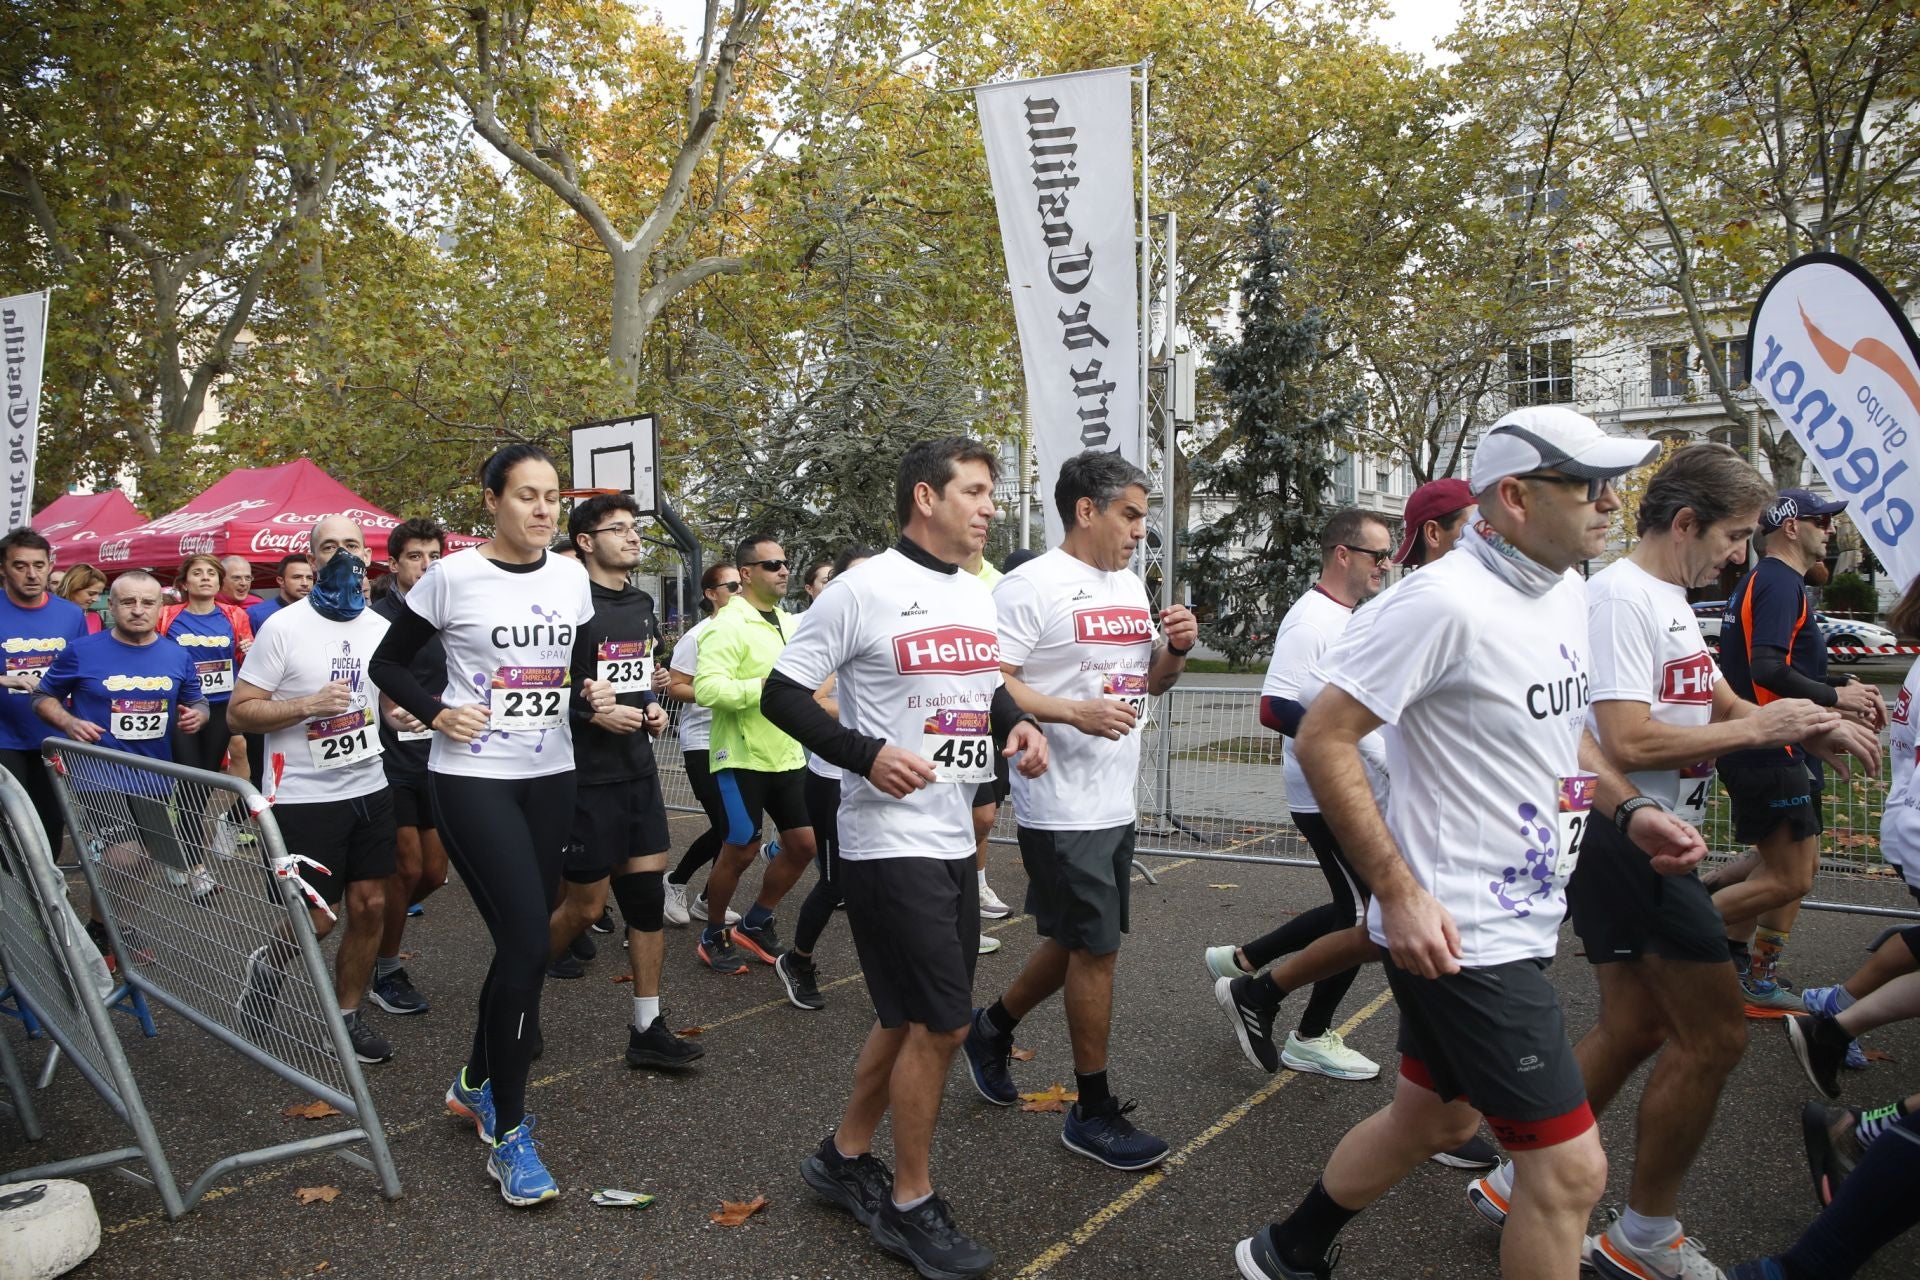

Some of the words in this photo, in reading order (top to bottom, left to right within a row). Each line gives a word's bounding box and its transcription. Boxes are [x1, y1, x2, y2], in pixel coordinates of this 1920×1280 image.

[251, 528, 312, 554] Coca-Co
[491, 623, 572, 649] curia
[331, 658, 361, 669] PUCELA
[906, 638, 1000, 667] Helios
[606, 661, 643, 683] 233
[504, 691, 561, 717] 232
[907, 695, 921, 708] El
[925, 692, 957, 707] sabor
[1526, 671, 1590, 720] curia
[119, 715, 161, 731] 632
[321, 729, 368, 761] 291
[932, 739, 988, 768] 458
[1685, 780, 1709, 811] 4
